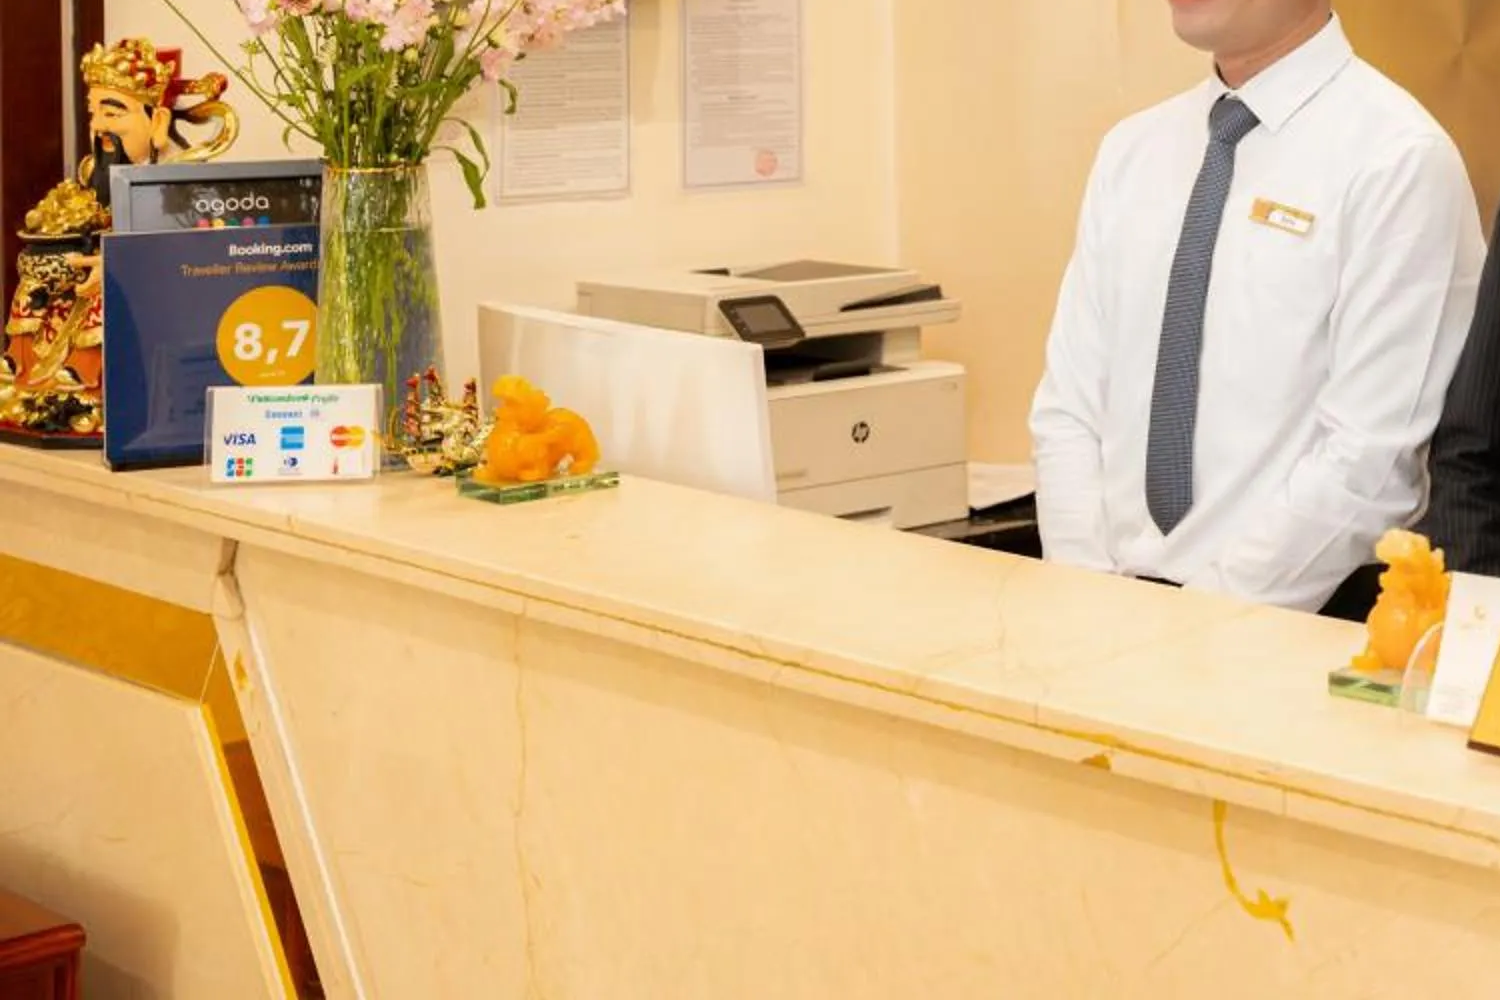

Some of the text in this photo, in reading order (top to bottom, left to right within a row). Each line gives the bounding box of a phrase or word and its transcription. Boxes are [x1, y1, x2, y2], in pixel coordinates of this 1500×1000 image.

[195, 191, 269, 216] agoda
[228, 242, 313, 257] Booking.com
[279, 257, 320, 271] Award
[233, 319, 311, 365] 8,7
[223, 432, 257, 446] VISA
